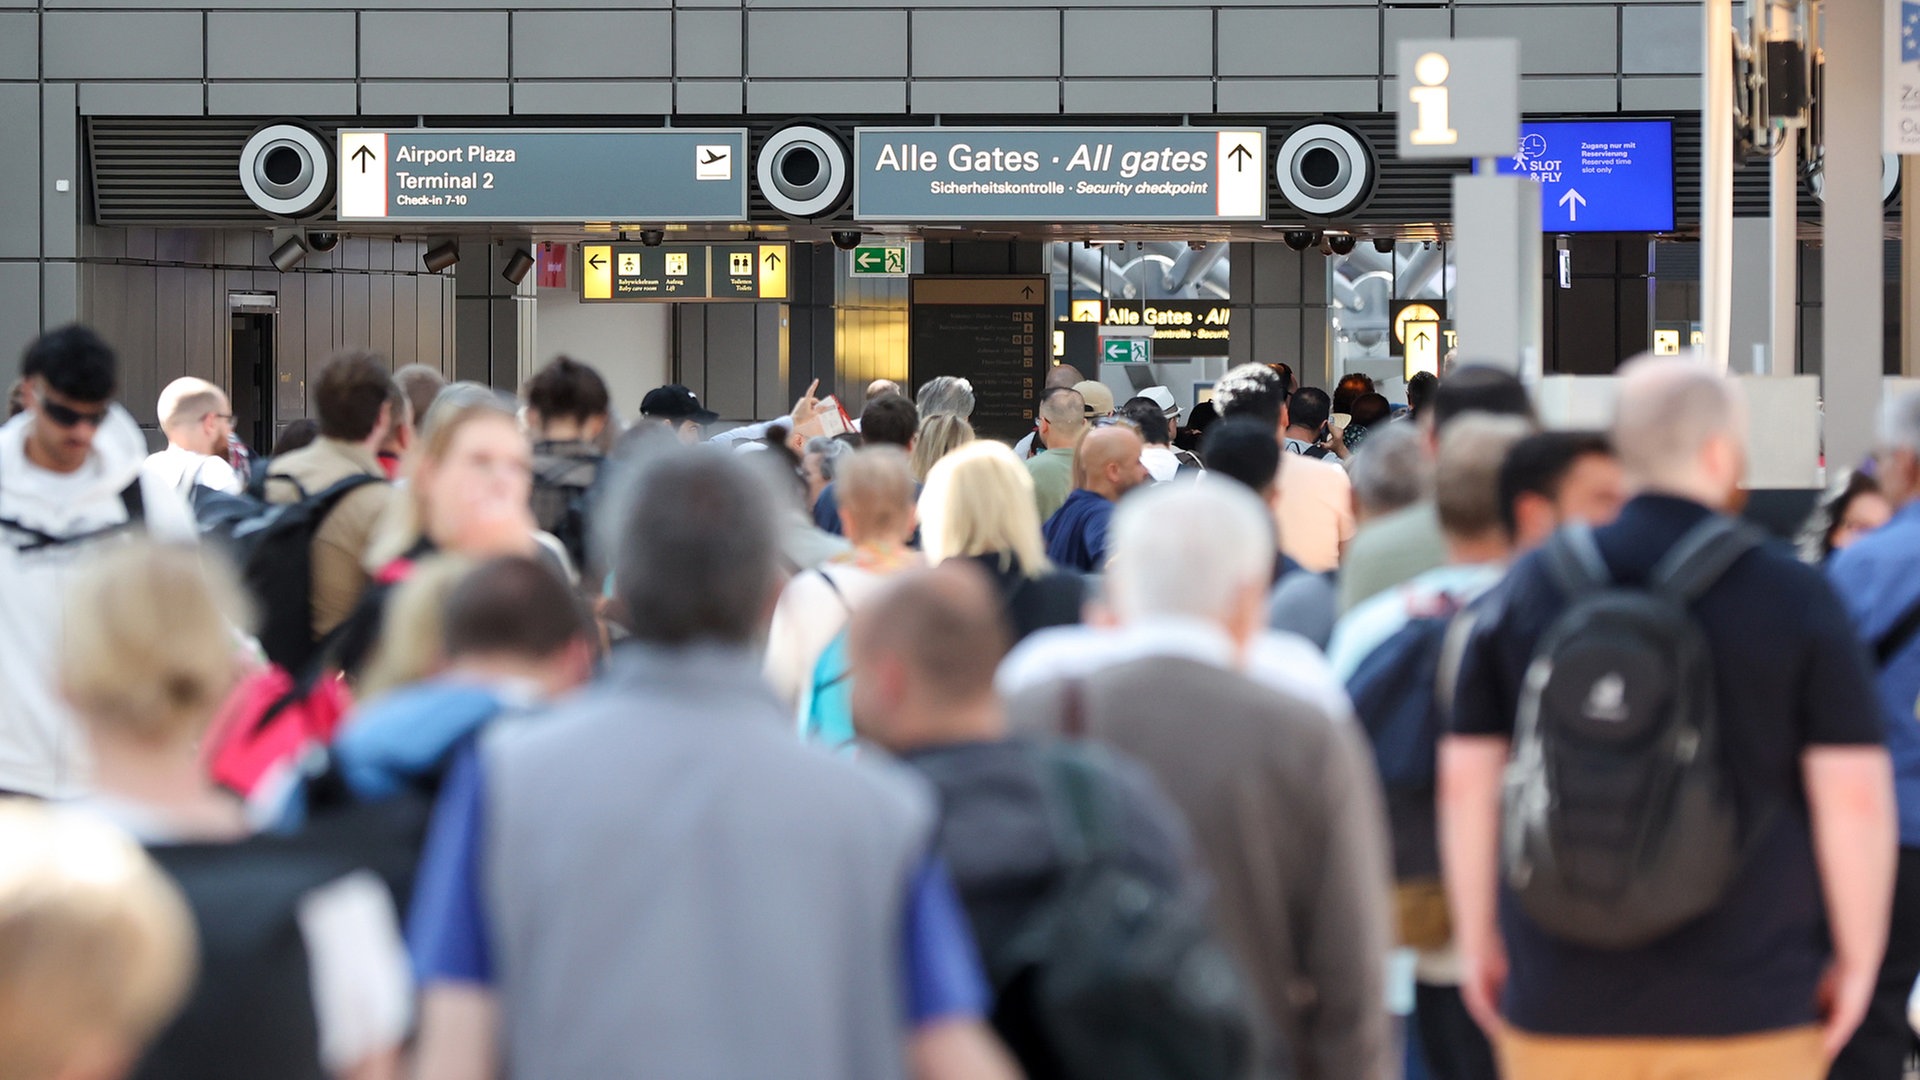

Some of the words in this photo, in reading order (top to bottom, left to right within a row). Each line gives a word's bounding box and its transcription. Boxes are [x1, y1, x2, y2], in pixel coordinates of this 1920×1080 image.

[1581, 142, 1609, 150] Zugang
[395, 145, 463, 166] Airport
[468, 145, 516, 163] Plaza
[875, 143, 938, 172] Alle
[948, 143, 1040, 172] Gates
[1065, 143, 1113, 172] All
[1119, 146, 1208, 178] gates
[1581, 150, 1628, 158] Reservierung
[1530, 160, 1562, 171] SLOT
[395, 172, 477, 189] Terminal
[482, 172, 494, 189] 2
[1542, 172, 1562, 183] FLY
[930, 180, 1065, 195] Sicherheitskontrolle
[1075, 180, 1134, 197] Security
[1134, 180, 1209, 197] checkpoint
[396, 194, 443, 206] Check-in
[444, 194, 467, 206] 7-10
[1105, 307, 1140, 325] Alle
[1142, 307, 1193, 325] Gates
[1204, 308, 1230, 325] All
